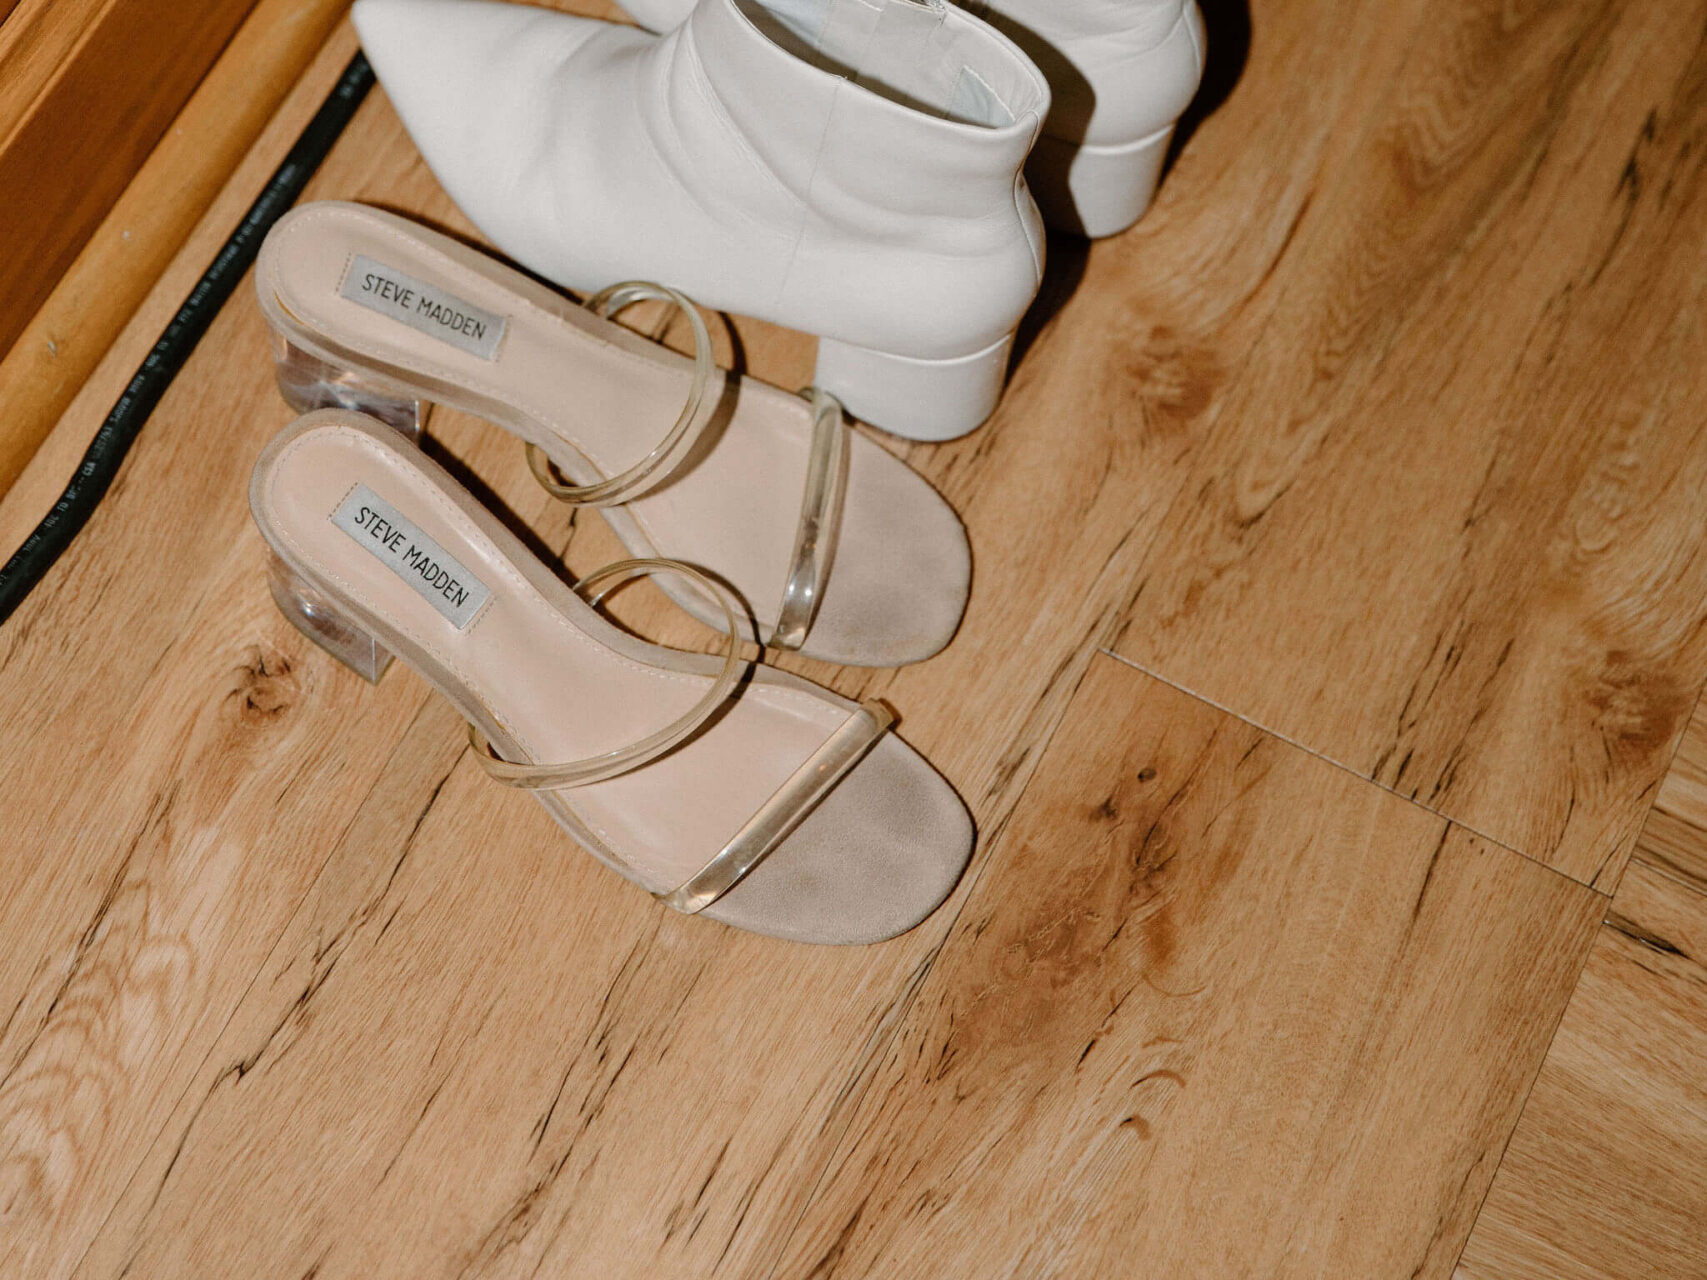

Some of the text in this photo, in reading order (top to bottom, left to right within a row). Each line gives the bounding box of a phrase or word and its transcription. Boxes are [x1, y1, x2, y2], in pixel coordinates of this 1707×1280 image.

[362, 273, 487, 340] STEVE MADDEN
[354, 507, 469, 608] STEVE MADDEN
